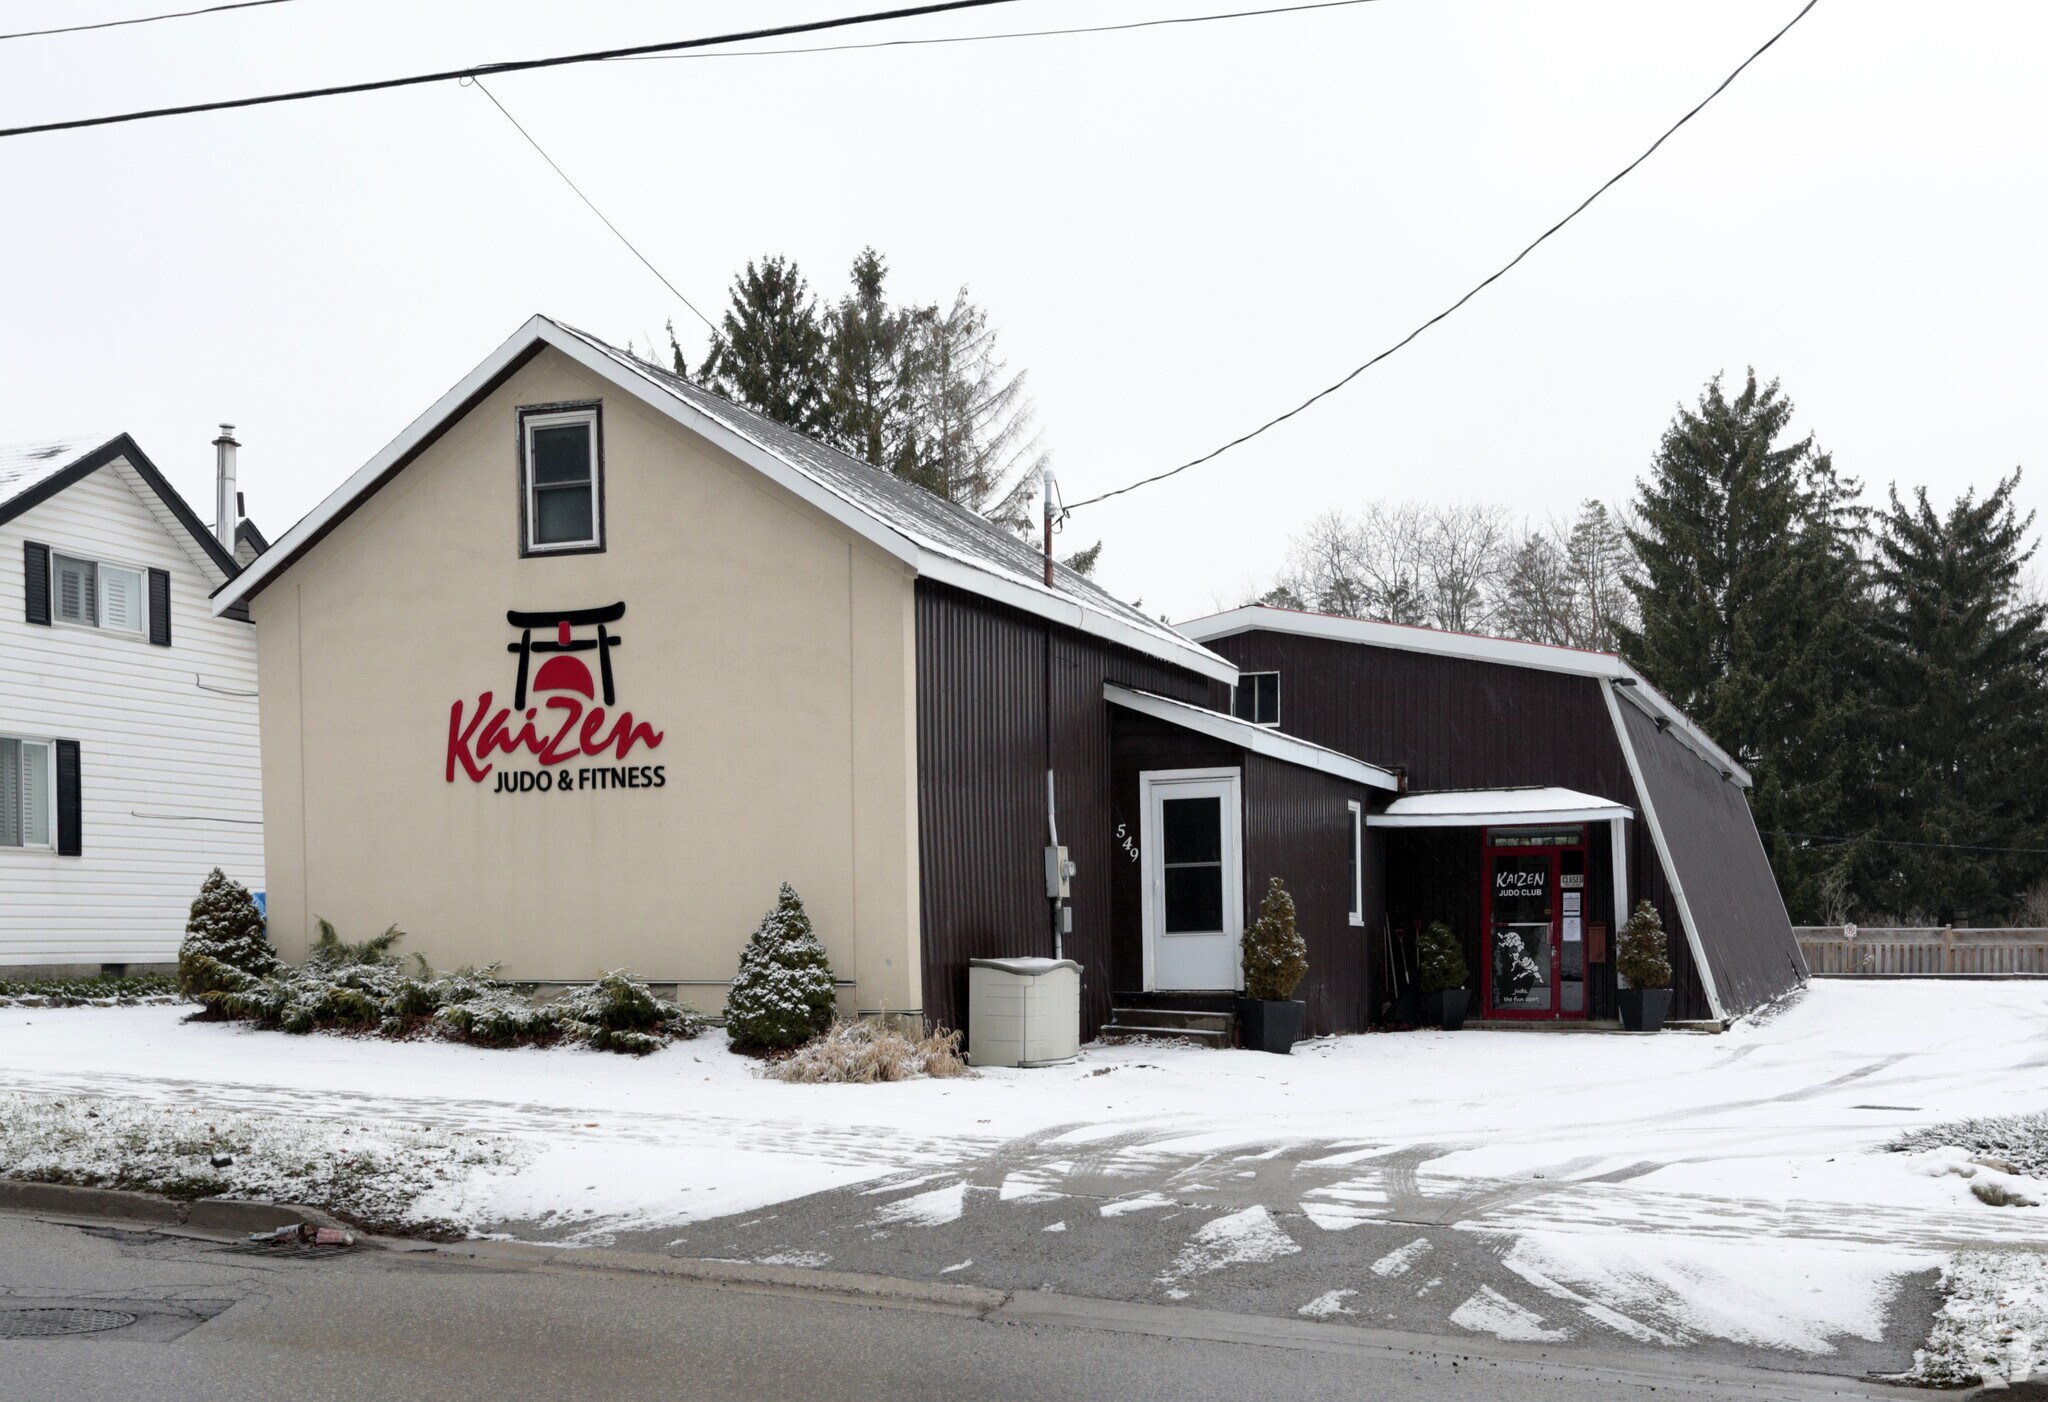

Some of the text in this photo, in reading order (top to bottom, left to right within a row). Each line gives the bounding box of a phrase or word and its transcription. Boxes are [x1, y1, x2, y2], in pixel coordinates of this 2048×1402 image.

[494, 765, 666, 793] JUDO & FITNESS
[1116, 823, 1139, 862] 549
[1496, 871, 1545, 888] KAIZEN
[1562, 875, 1584, 884] CLOSED
[1499, 888, 1542, 897] JUDO CLUB
[1513, 995, 1525, 1004] fun
